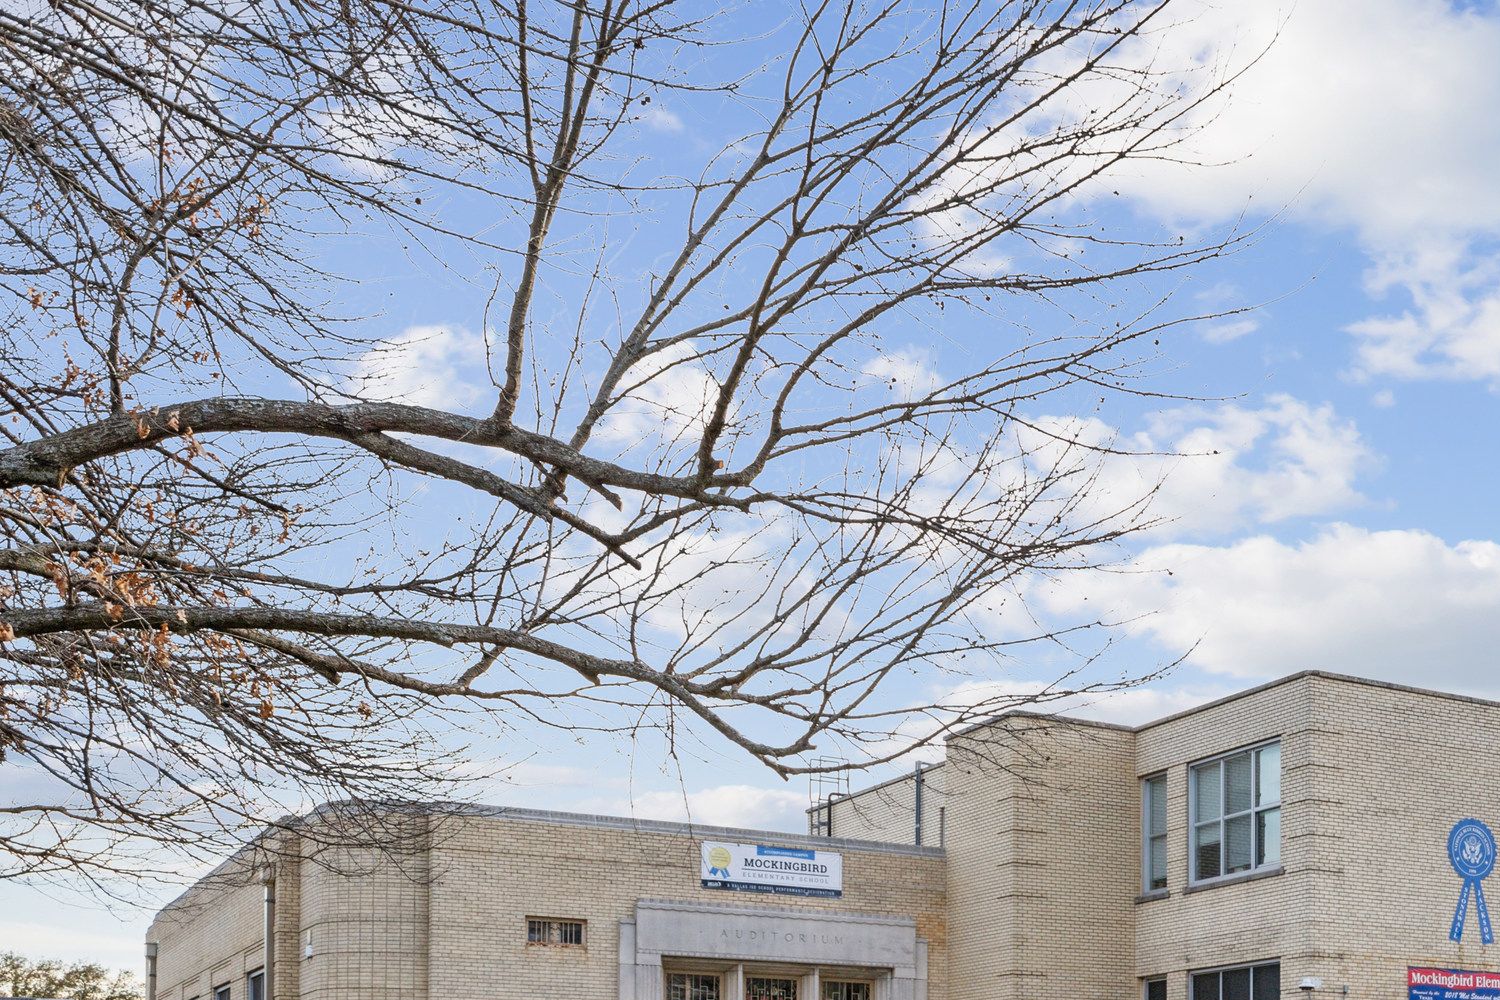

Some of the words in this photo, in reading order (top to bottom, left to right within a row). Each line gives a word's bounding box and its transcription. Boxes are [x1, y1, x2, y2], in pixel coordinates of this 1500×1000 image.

[743, 857, 828, 874] MOCKINGBIRD
[742, 872, 796, 882] ELEMENTARY
[799, 876, 829, 885] SCHOOL
[1453, 886, 1469, 939] STONEWALL
[1477, 889, 1490, 940] JACKSON
[720, 929, 844, 945] AUDITORIUM
[1411, 971, 1473, 988] Mockingbird
